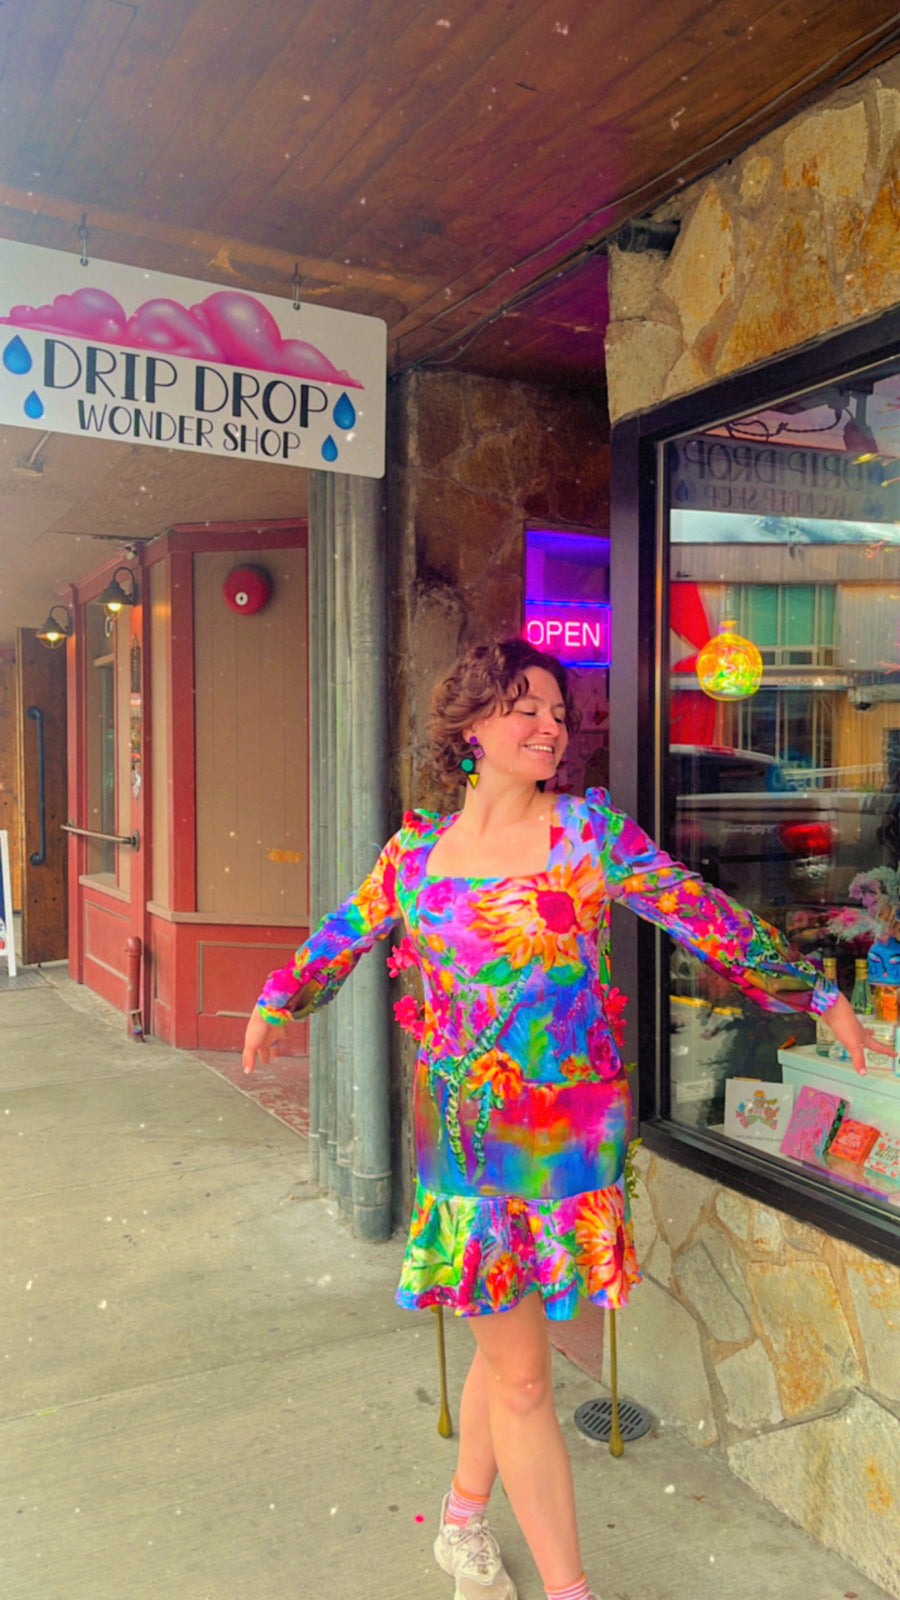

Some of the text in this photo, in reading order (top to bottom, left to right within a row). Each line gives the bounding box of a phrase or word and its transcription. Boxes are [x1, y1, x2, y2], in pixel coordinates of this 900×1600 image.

[43, 338, 328, 428] DRIP DROP
[77, 399, 301, 459] WONDER SHOP
[526, 620, 600, 647] OPEN
